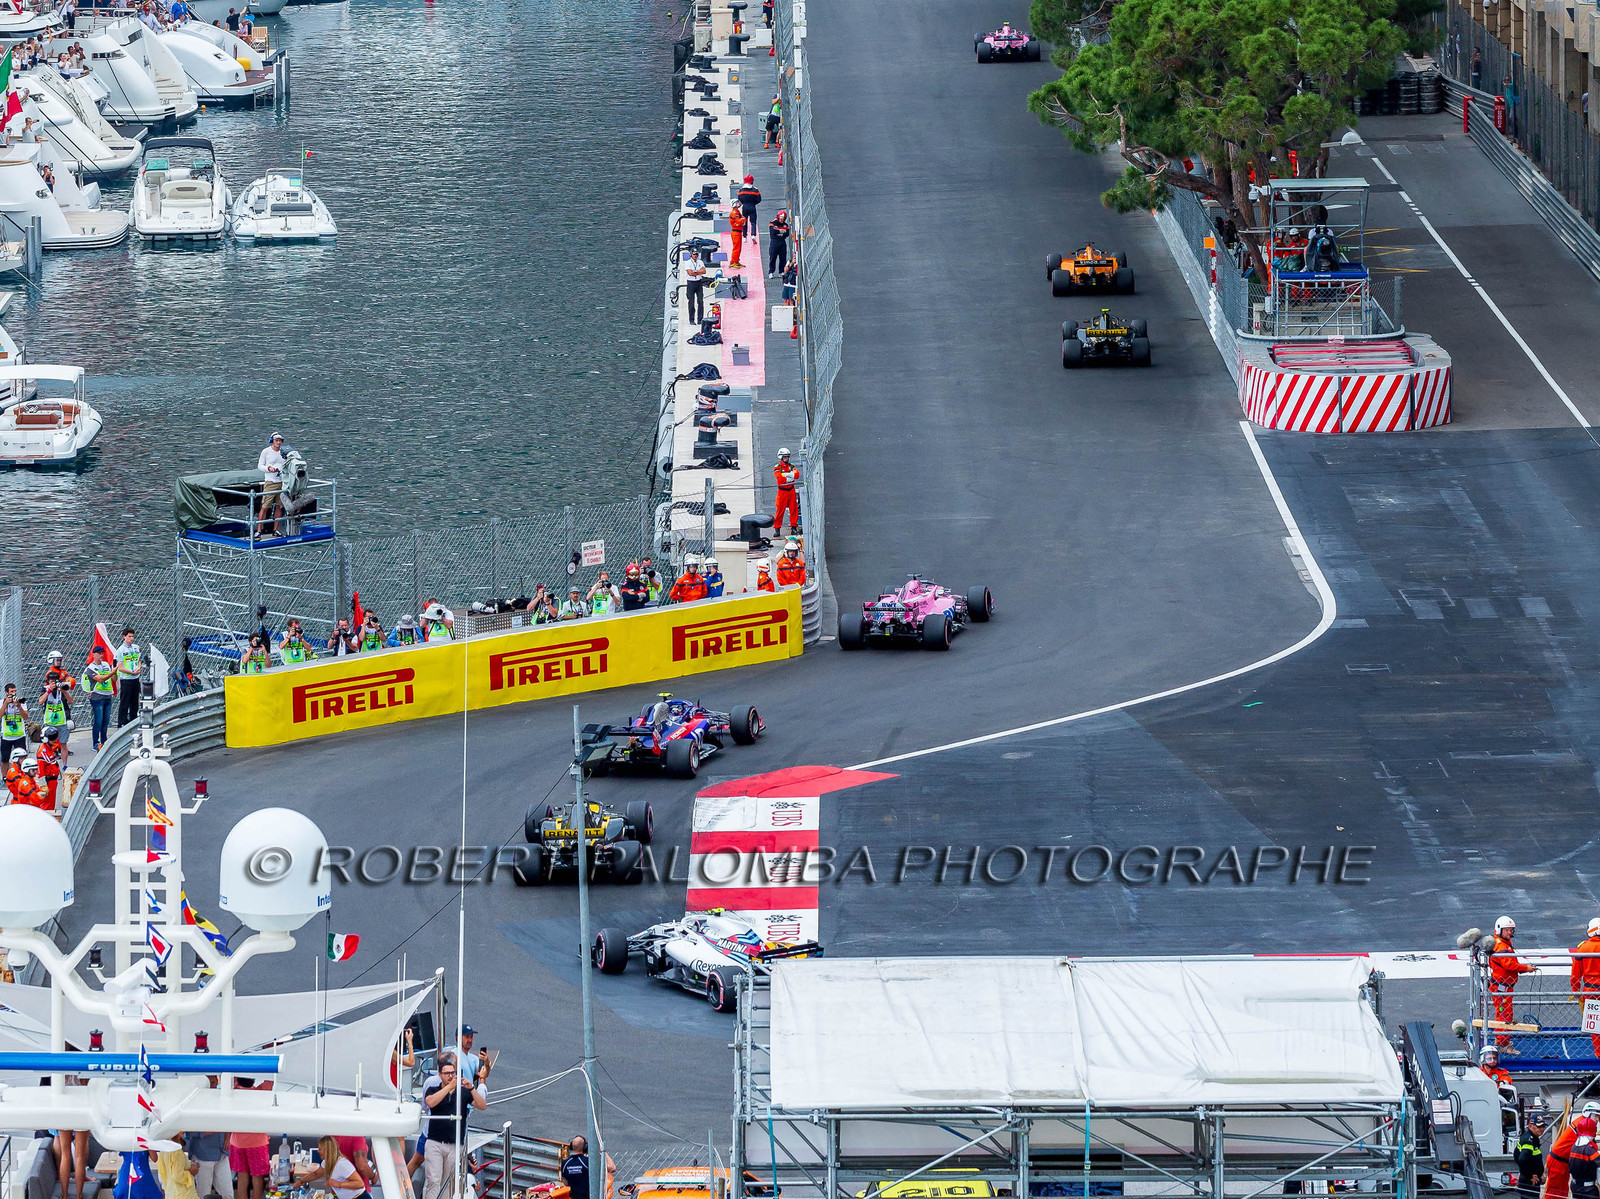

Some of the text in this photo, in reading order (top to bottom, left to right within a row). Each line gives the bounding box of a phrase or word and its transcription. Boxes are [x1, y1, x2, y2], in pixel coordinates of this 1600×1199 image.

[672, 608, 789, 662] PIRELLI
[489, 637, 610, 691] PIRELLI
[292, 667, 415, 723] PIRELLI
[771, 809, 802, 827] UBS
[766, 922, 800, 942] UBS
[716, 937, 748, 953] MARTINI
[695, 959, 725, 973] Rexo
